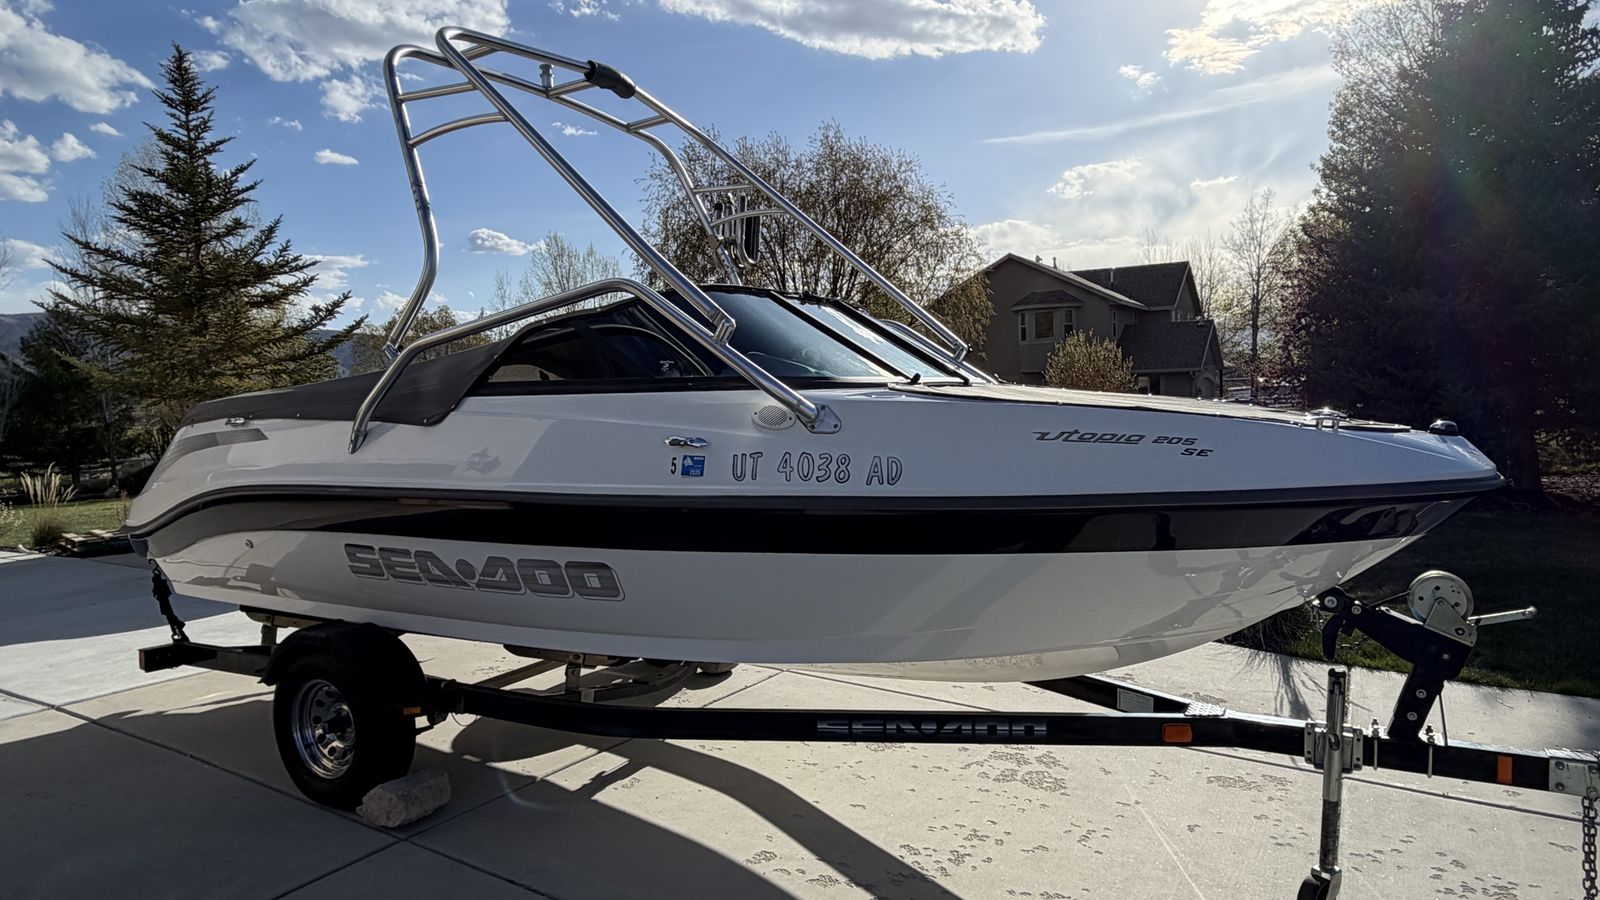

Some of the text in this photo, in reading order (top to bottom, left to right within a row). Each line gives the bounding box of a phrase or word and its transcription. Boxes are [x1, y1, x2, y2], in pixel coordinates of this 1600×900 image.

[1032, 429, 1198, 446] Utopia 205
[1180, 448, 1214, 457] SE
[670, 457, 677, 475] 5
[732, 452, 903, 485] UT 4038 AD
